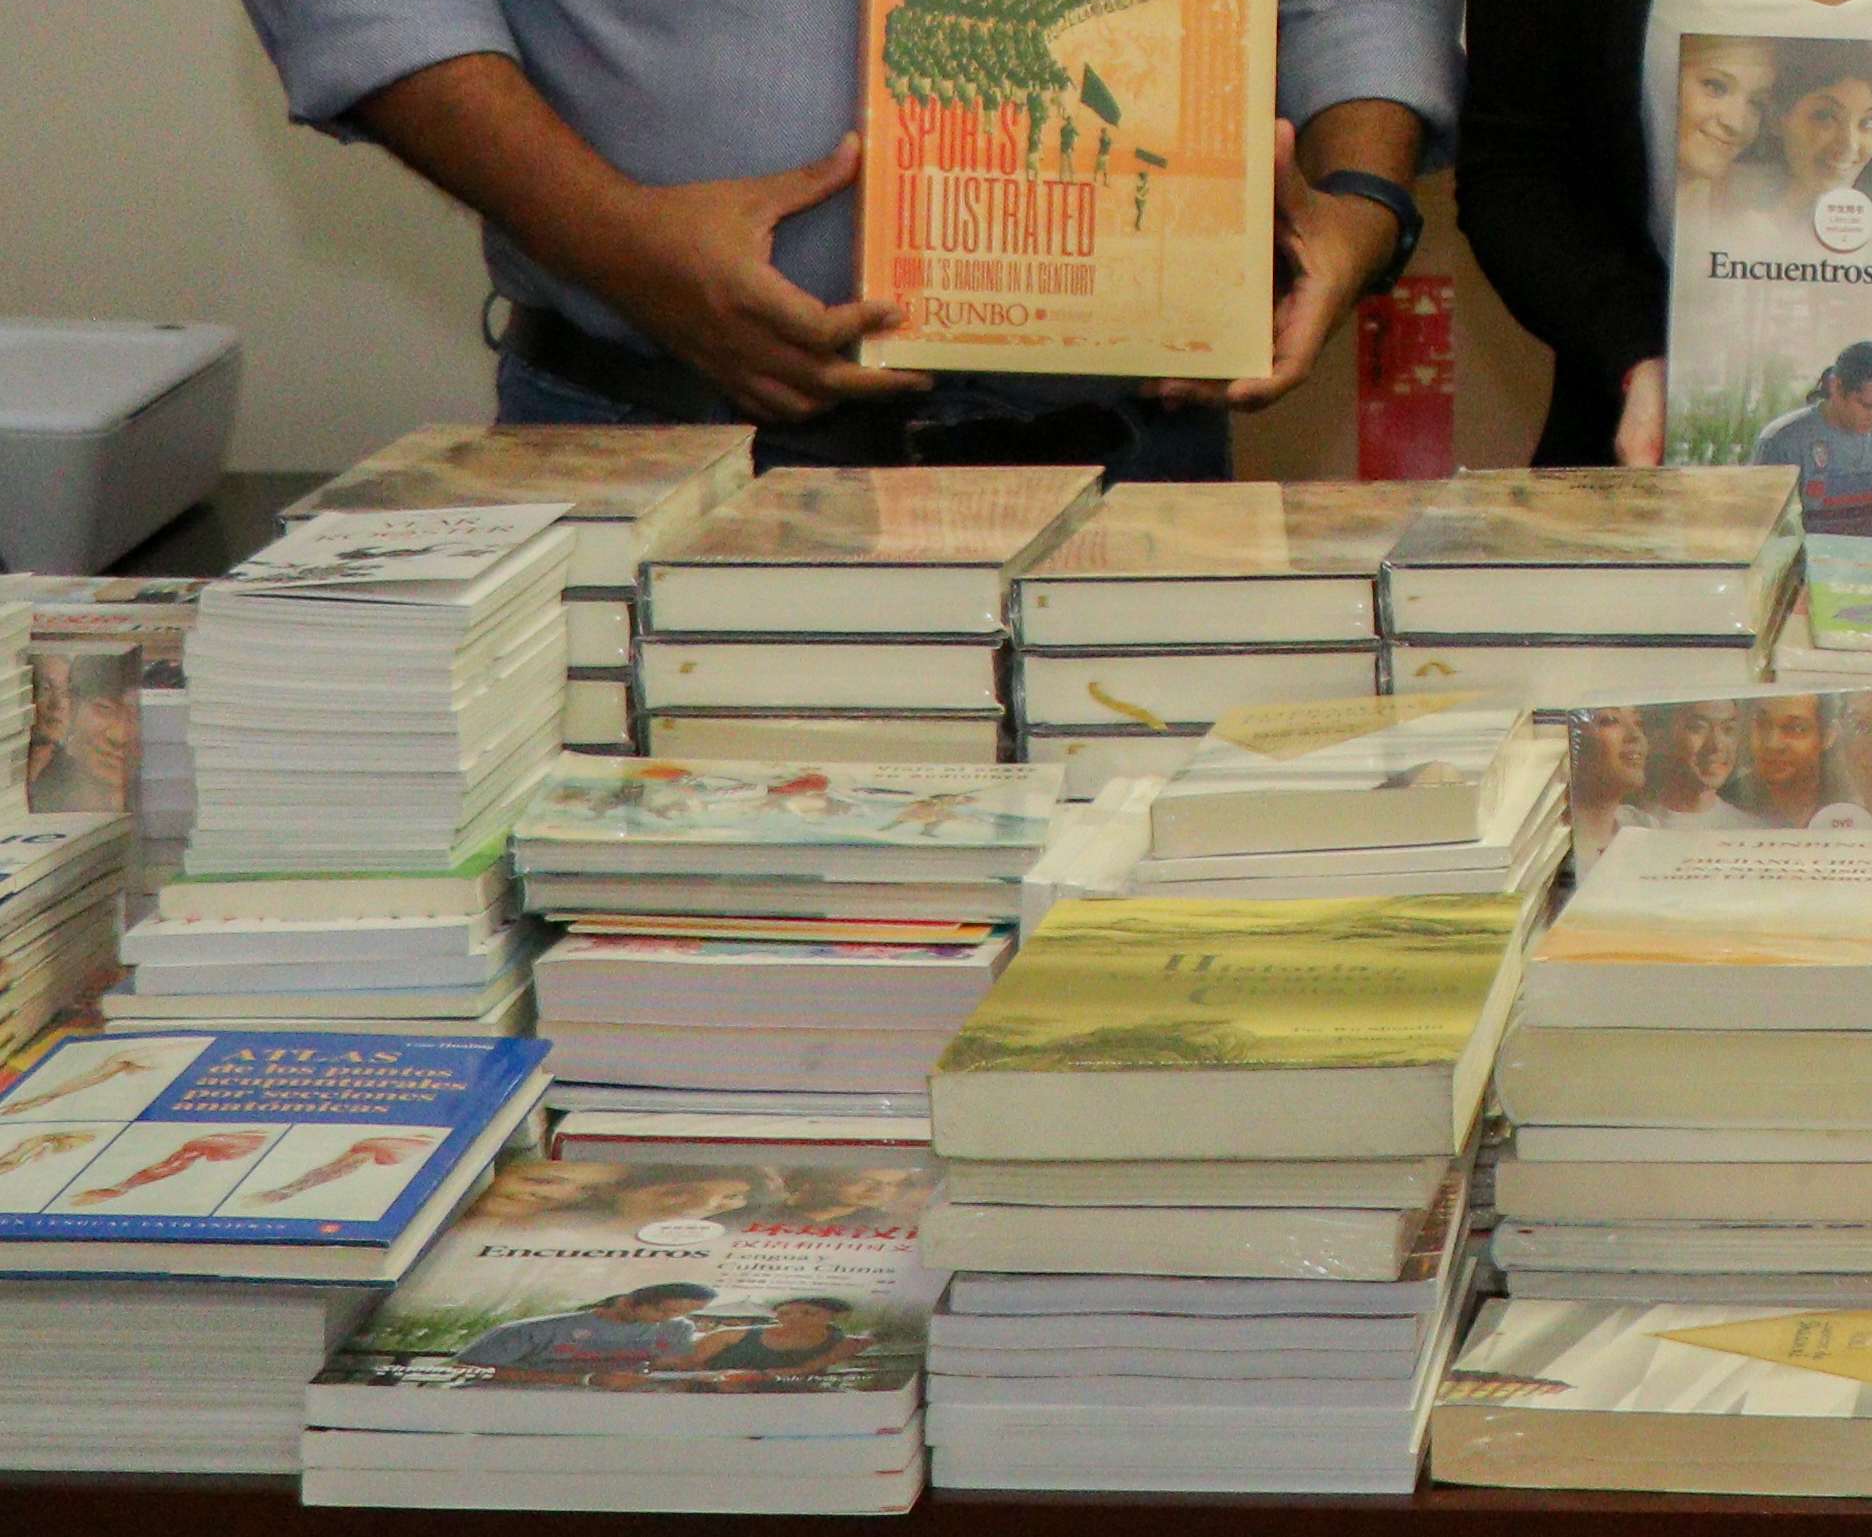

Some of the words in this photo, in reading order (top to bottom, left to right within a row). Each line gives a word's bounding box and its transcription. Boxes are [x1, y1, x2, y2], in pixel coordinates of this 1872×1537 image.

[895, 174, 1096, 258] ILLUSTRATED
[922, 296, 1029, 329] RUNBO
[221, 1047, 402, 1064] ATLAS
[209, 1063, 255, 1074] de
[264, 1063, 314, 1075] los
[324, 1066, 454, 1079] puntos
[196, 1076, 466, 1091] acupunturales
[183, 1088, 255, 1101] por
[263, 1088, 436, 1102] secciones
[476, 1242, 711, 1260] Encuentros
[716, 1262, 805, 1272] Cultura
[812, 1263, 896, 1274] Chinas
